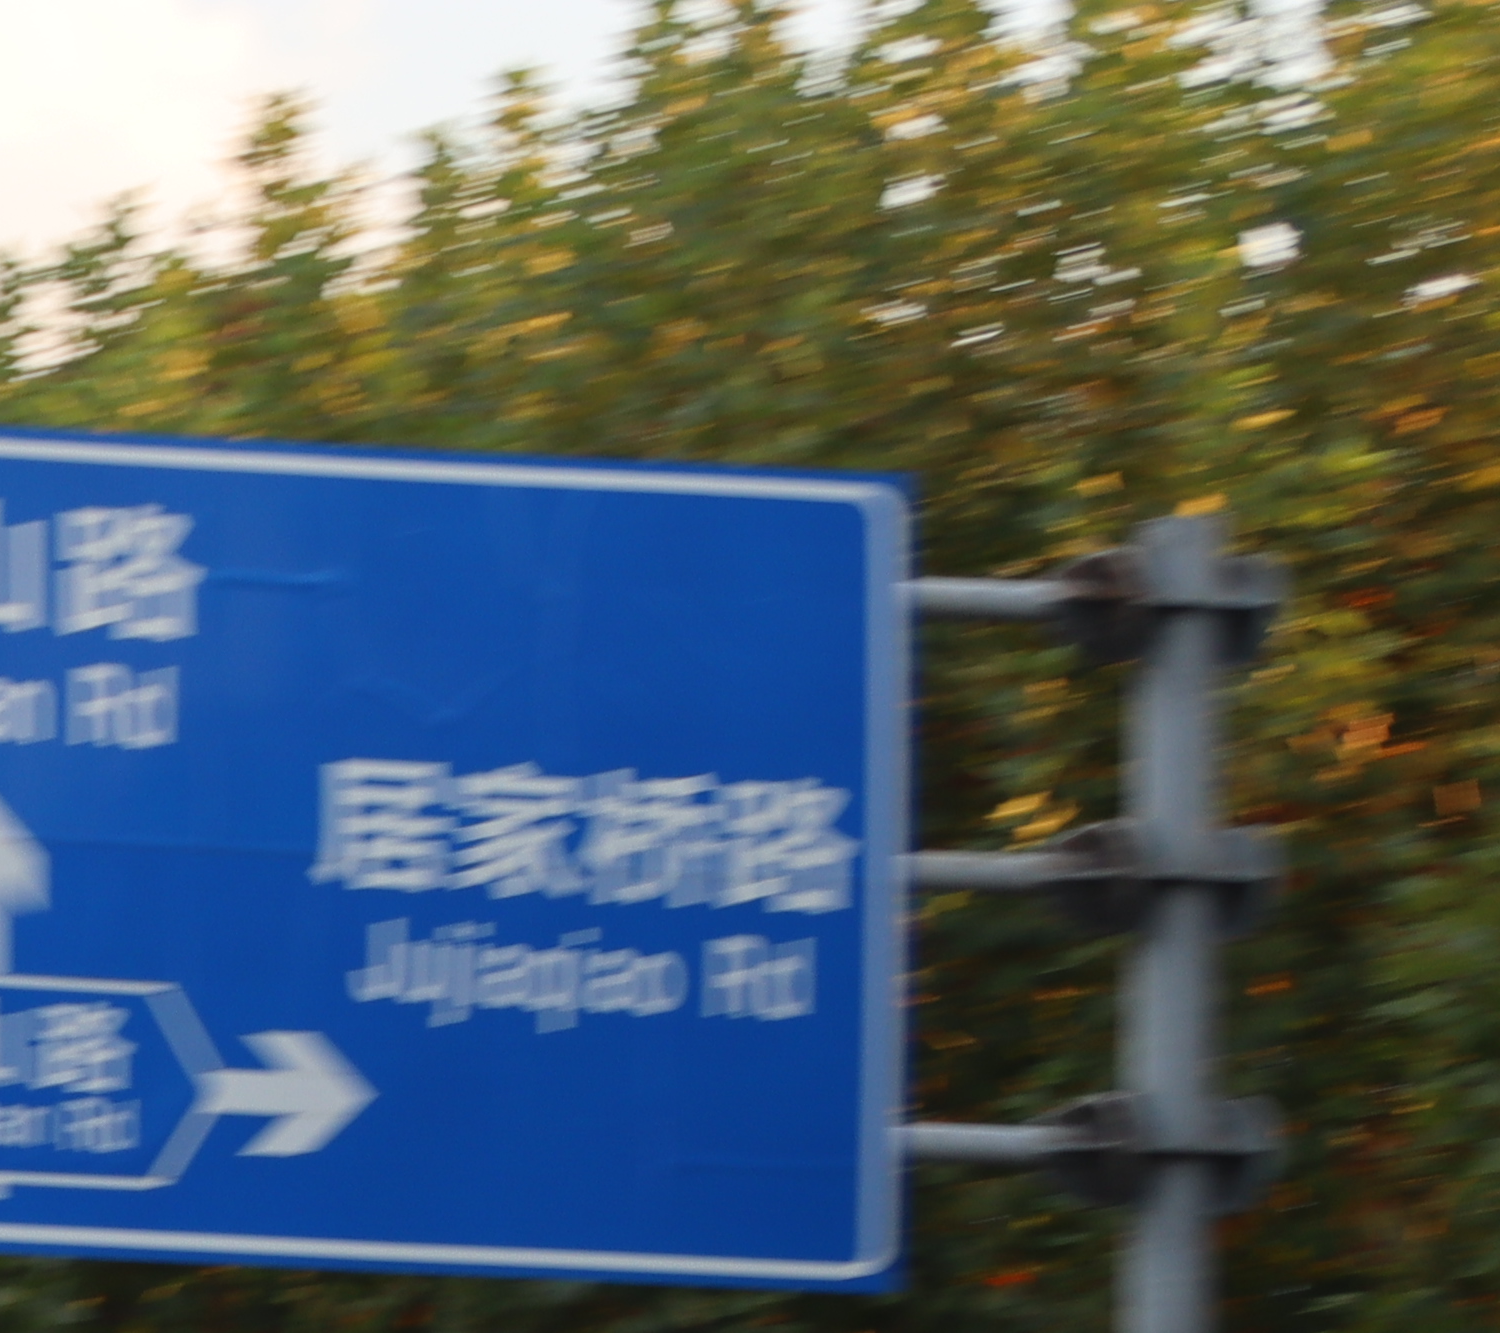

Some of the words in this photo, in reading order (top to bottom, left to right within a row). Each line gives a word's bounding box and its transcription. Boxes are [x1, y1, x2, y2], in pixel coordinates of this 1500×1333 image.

[64, 663, 180, 750] Rd
[306, 758, 862, 914] 居家桥路
[346, 918, 688, 1034] Jujiaqiao
[701, 935, 817, 1021] Rd
